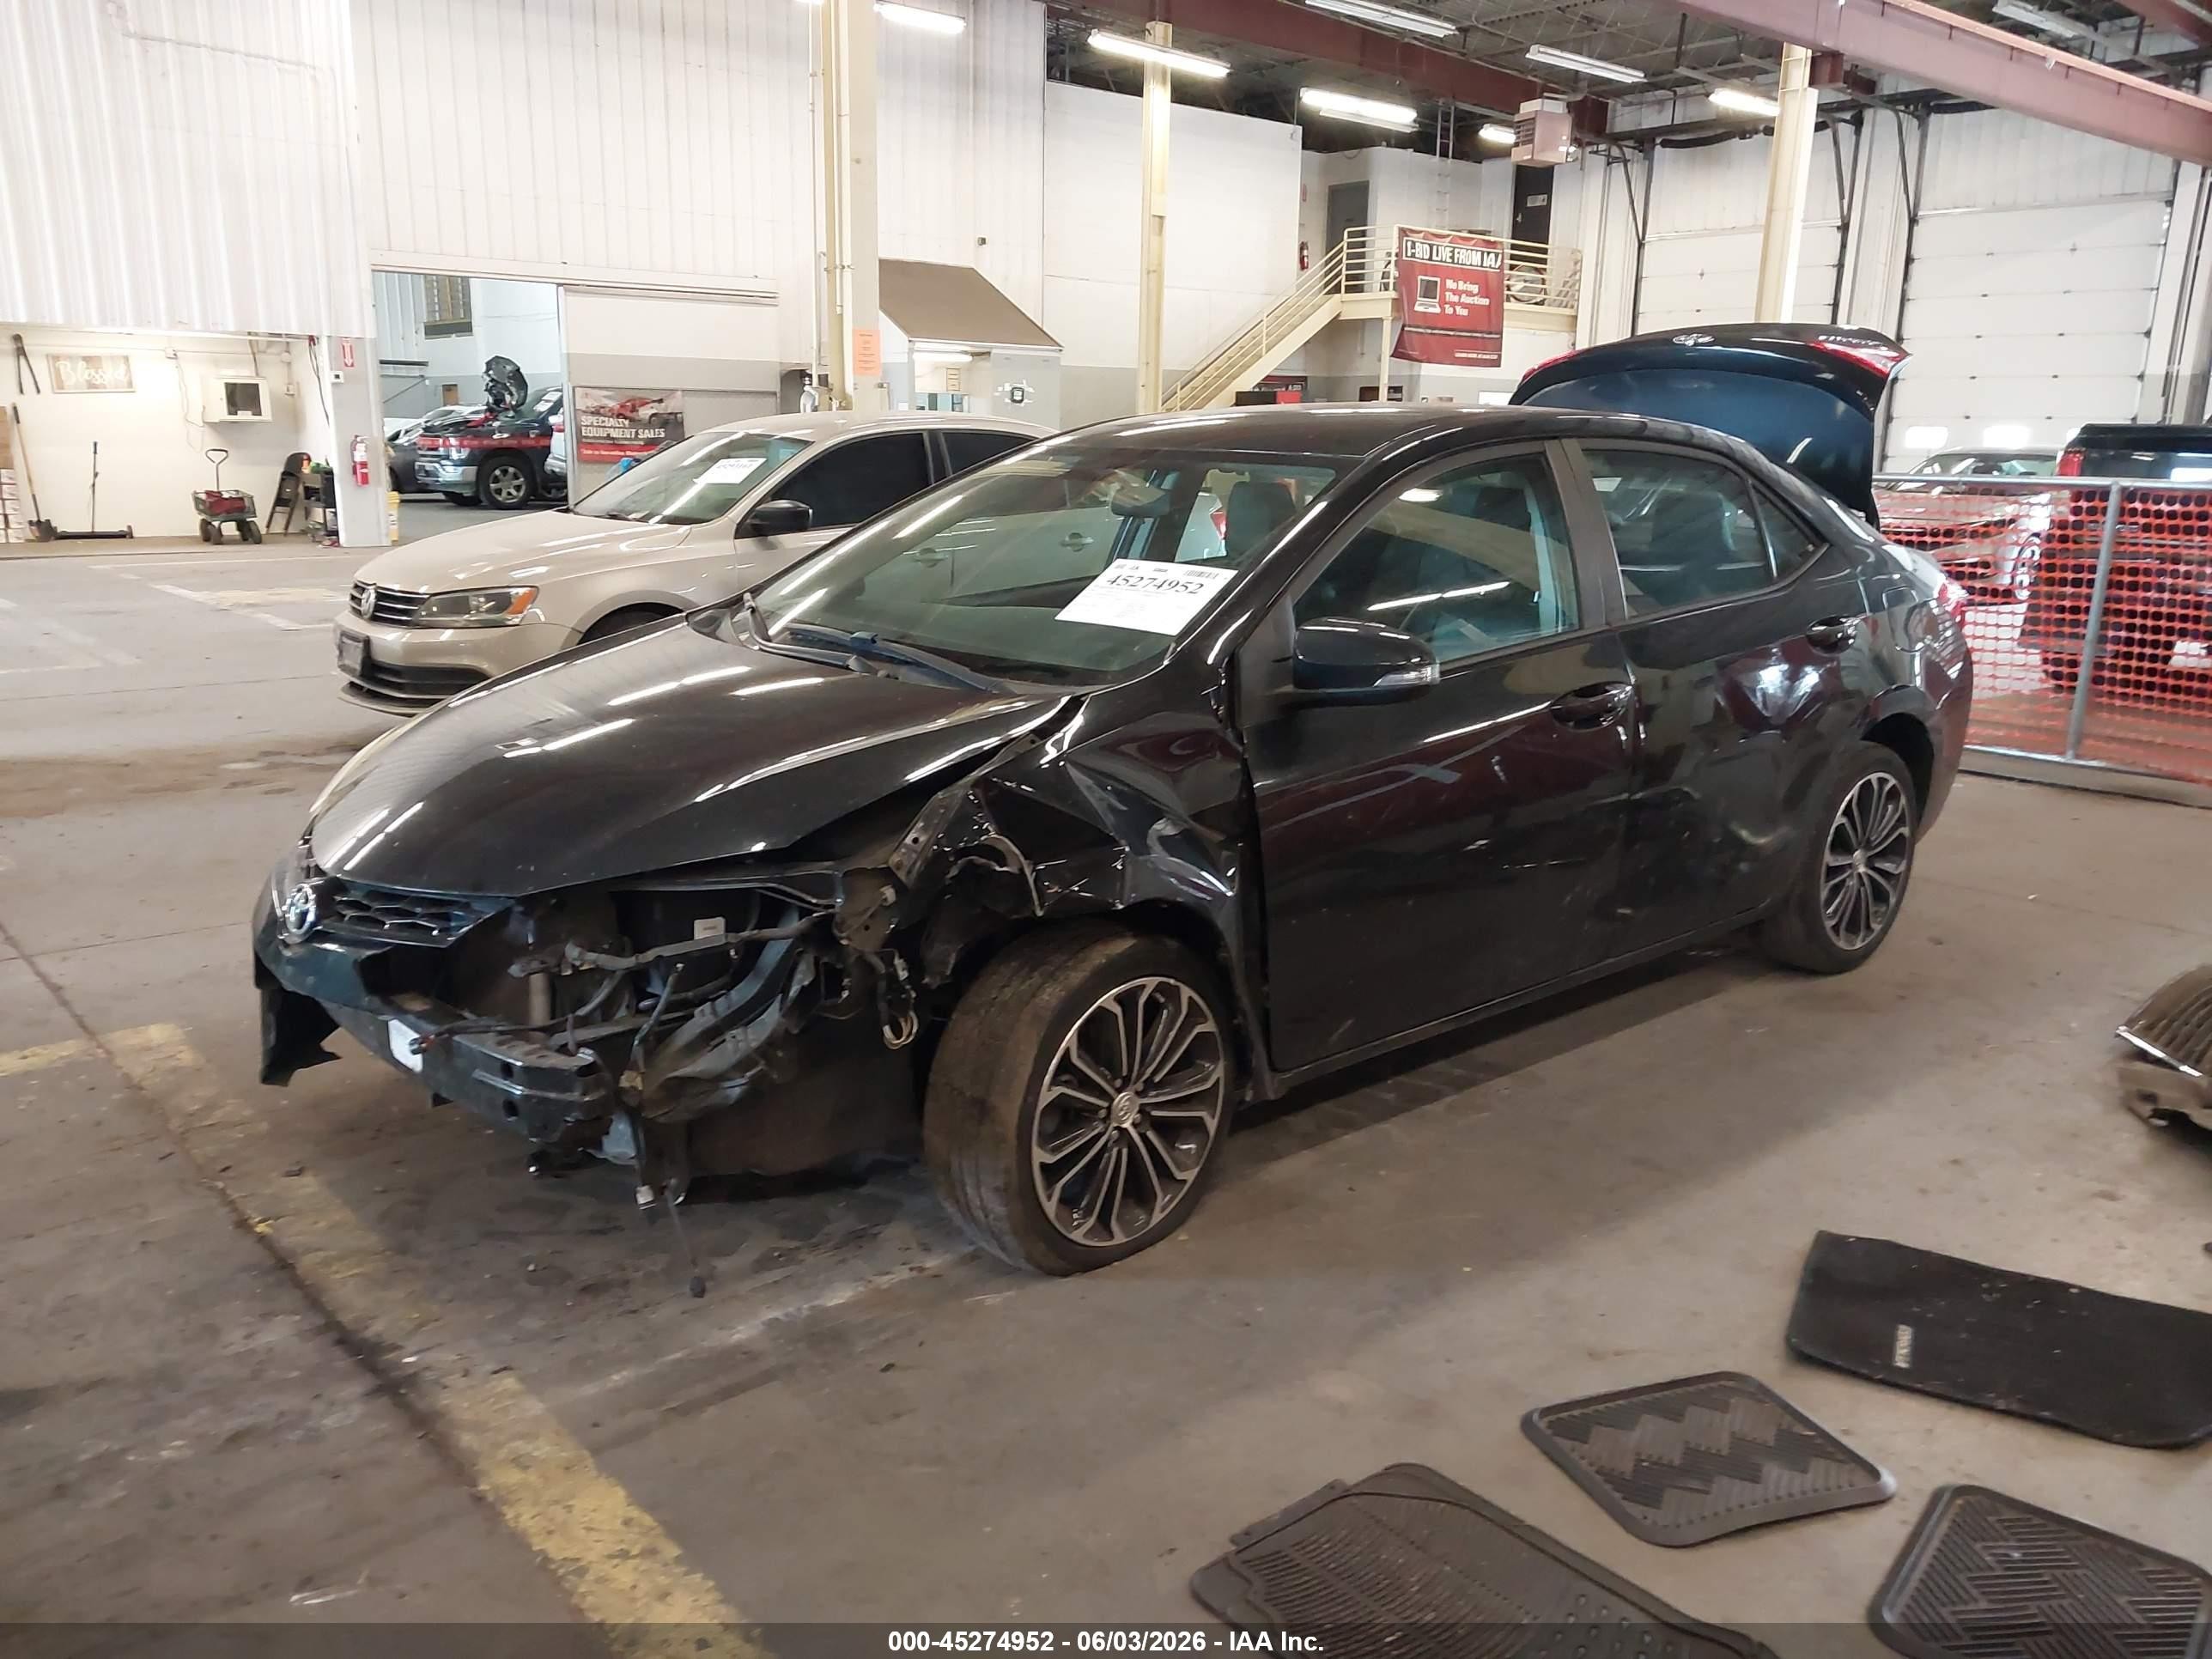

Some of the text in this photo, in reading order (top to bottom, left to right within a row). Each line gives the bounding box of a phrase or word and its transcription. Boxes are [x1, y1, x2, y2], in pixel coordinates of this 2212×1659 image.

[1407, 240, 1431, 258] I-BID
[1432, 245, 1453, 262] LIVE
[1455, 250, 1482, 266] FROM
[1459, 281, 1479, 293] Bring
[1445, 293, 1489, 305] The Auction
[1444, 305, 1468, 316] To You
[580, 416, 629, 428] SPECIALTY
[581, 426, 665, 439] EQUIPMENT SALES
[1106, 574, 1205, 595] 45274952
